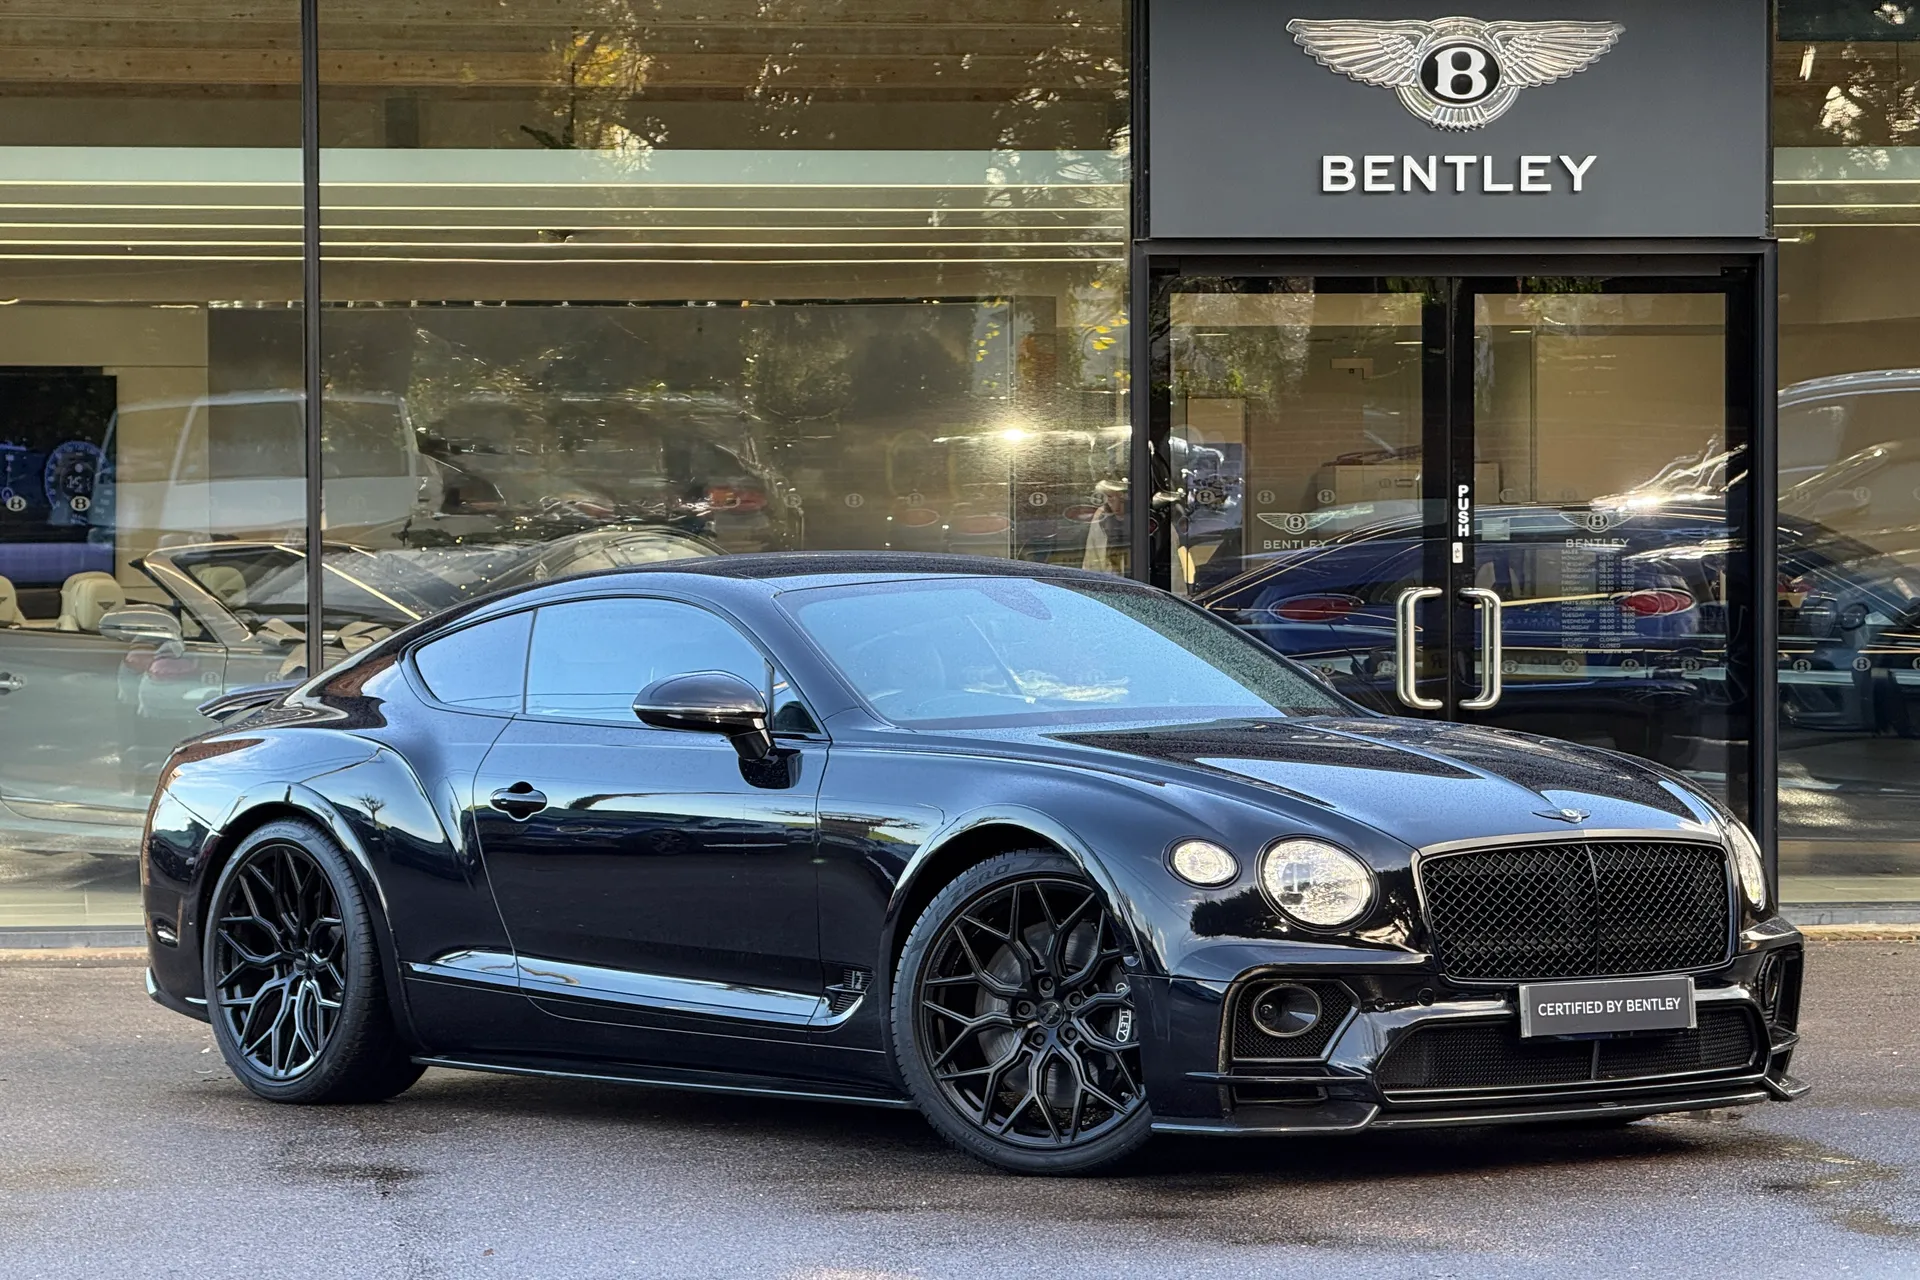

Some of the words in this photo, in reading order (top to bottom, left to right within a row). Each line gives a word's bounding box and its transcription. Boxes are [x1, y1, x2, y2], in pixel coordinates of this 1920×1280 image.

[1434, 47, 1487, 99] B
[1322, 155, 1597, 192] BENTLEY
[1458, 484, 1469, 537] PUSH
[1290, 516, 1302, 529] B
[1263, 539, 1327, 549] BENTLEY
[1566, 538, 1630, 548] BENTLEY
[1538, 1001, 1603, 1016] CERTIFIED
[1606, 1000, 1623, 1013] BY
[1626, 997, 1681, 1012] BENTLEY
